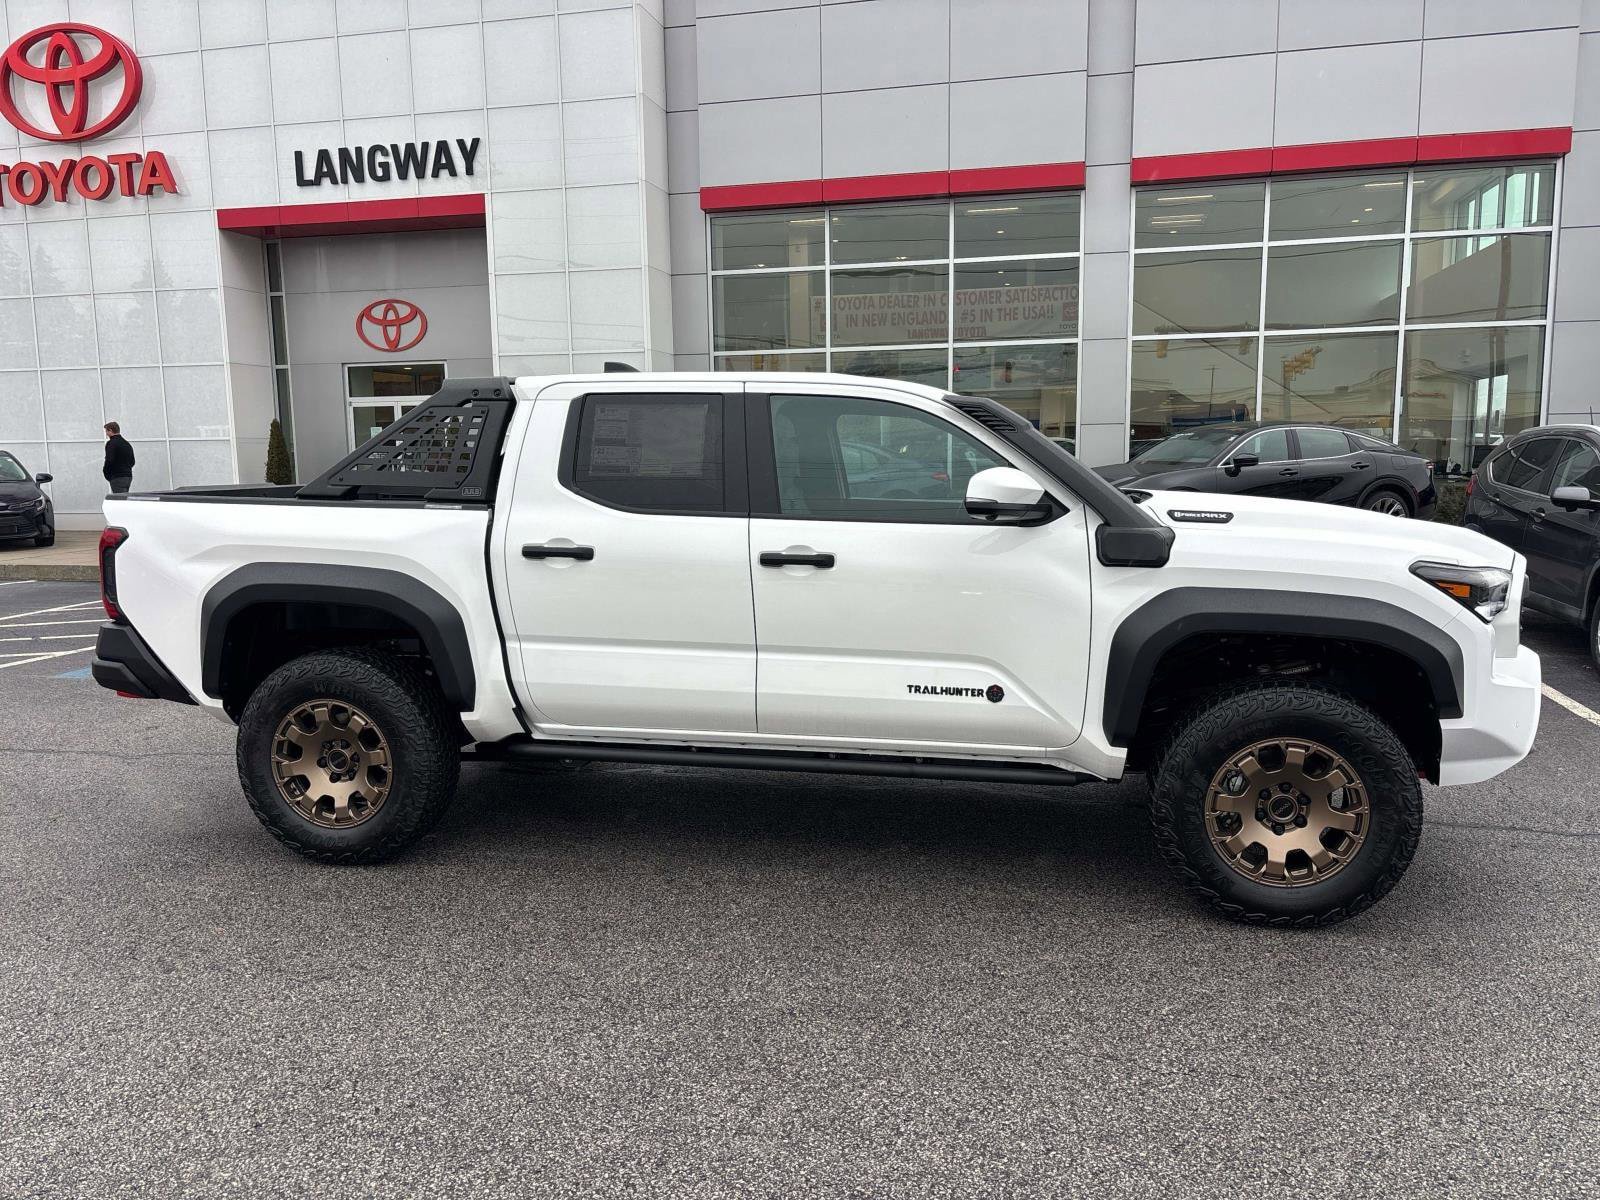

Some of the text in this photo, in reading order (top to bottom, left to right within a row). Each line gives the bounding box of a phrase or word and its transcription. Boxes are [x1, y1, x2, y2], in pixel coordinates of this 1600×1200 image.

[294, 137, 480, 187] LANGWAY
[832, 296, 874, 311] TOYOTA
[878, 294, 919, 309] DEALER
[923, 294, 936, 307] IN
[941, 290, 1002, 306] CSTOMER
[1005, 286, 1078, 304] SATISFACTIO
[846, 313, 858, 328] IN
[862, 312, 887, 328] NEW
[960, 308, 976, 323] #5
[980, 308, 993, 322] IN
[997, 306, 1019, 322] THE
[1022, 303, 1054, 320] USA!!
[906, 684, 984, 697] TRAILHUNTER
